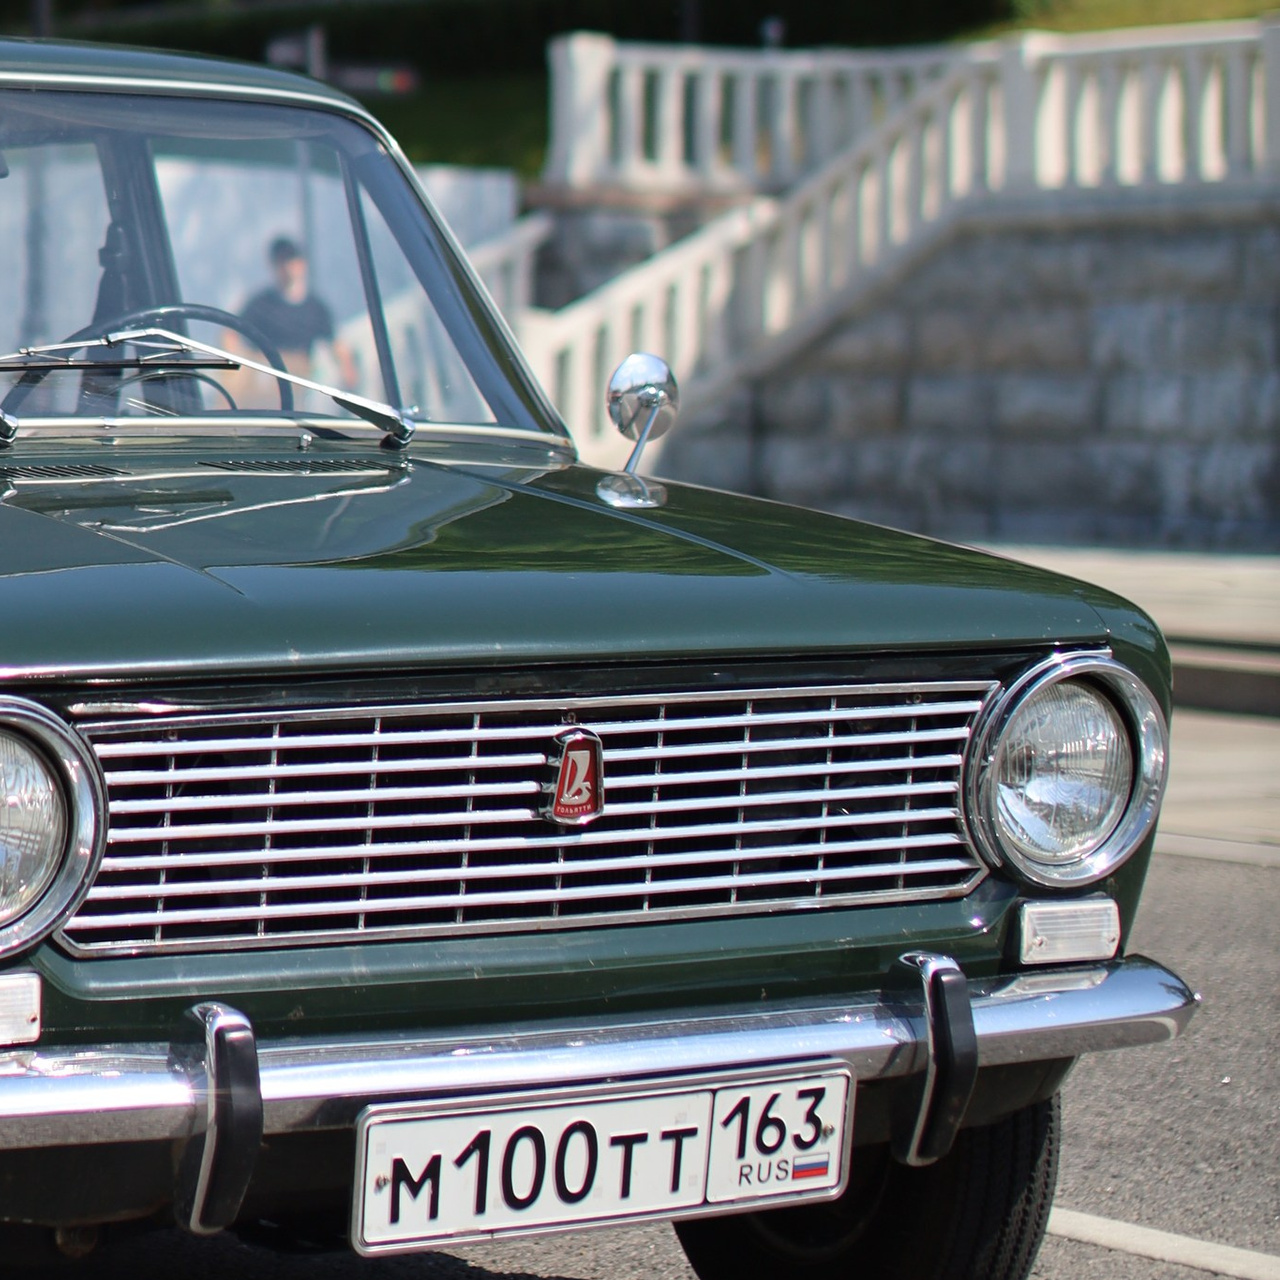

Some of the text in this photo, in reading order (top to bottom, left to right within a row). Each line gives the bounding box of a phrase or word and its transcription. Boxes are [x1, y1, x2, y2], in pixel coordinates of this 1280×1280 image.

[556, 804, 592, 814] ТОЛЬЯТТИ
[389, 1087, 827, 1223] М100ТТ 163
[738, 1159, 789, 1186] RUS
